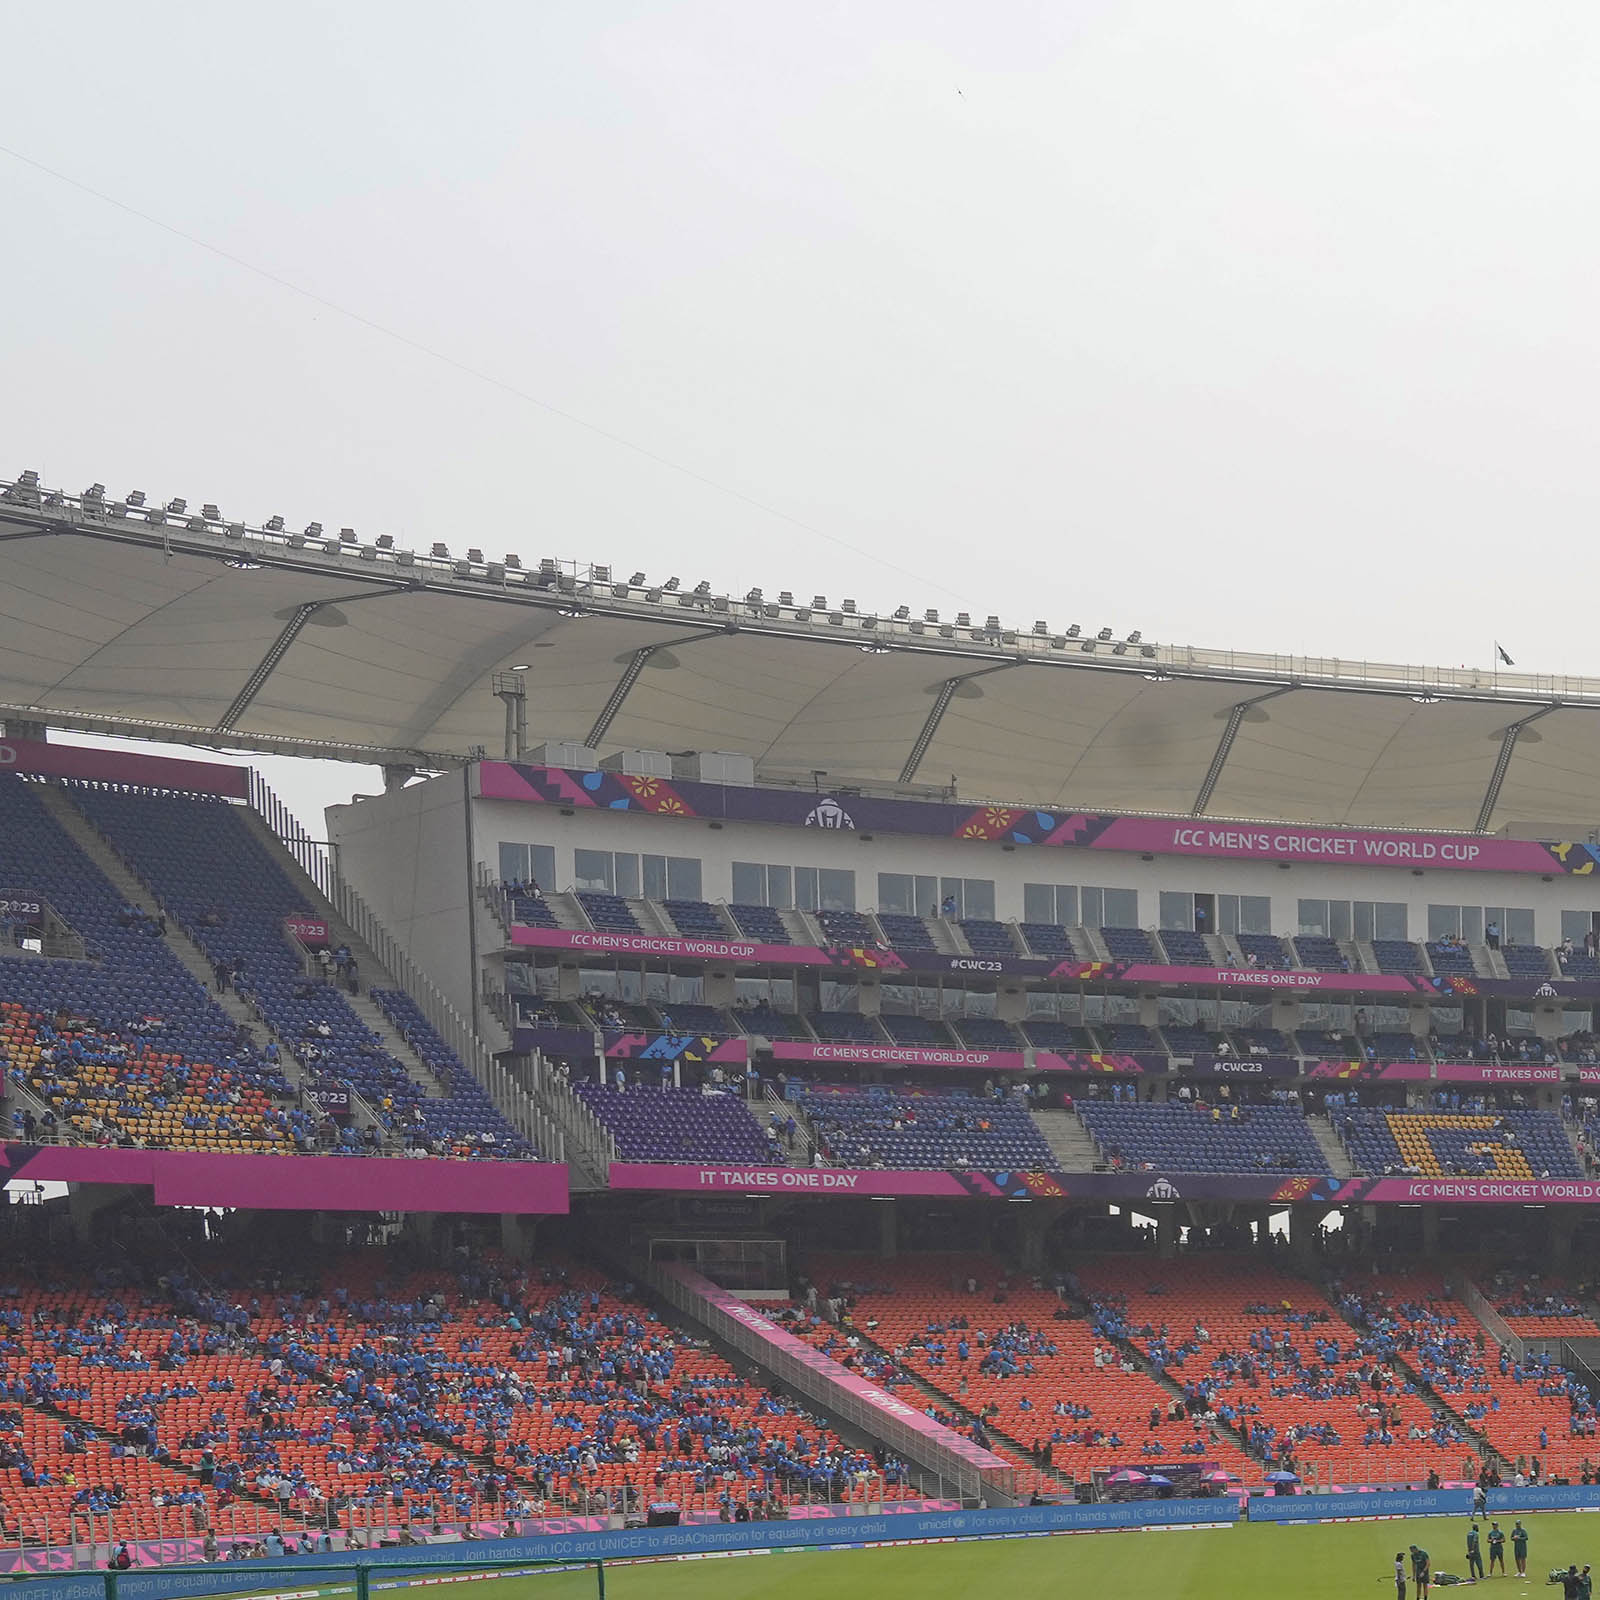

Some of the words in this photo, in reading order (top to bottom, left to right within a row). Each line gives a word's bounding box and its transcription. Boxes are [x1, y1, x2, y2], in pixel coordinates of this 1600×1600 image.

[1174, 828, 1202, 844] ICC
[1208, 831, 1270, 849] MEN'S
[1274, 835, 1357, 854] CRICKET
[1364, 840, 1435, 858] WORLD
[1441, 844, 1480, 861] CUP
[571, 935, 591, 945] ICC
[592, 936, 629, 948] MEN'S
[631, 938, 681, 951] CRICKET
[685, 942, 728, 954] WORLD
[730, 945, 754, 955] CUP
[951, 960, 1002, 971] #CWC23
[1218, 972, 1229, 981] IT
[1231, 973, 1269, 983] TAKES
[1271, 974, 1296, 984] ONE
[1298, 975, 1322, 985] DAY
[813, 1047, 830, 1057] ICC
[833, 1048, 869, 1059] MEN'S
[871, 1050, 919, 1060] CRICKET
[922, 1051, 964, 1062] WORLD
[966, 1054, 989, 1063] CUP
[1213, 1062, 1263, 1072] #CWC23
[1482, 1069, 1493, 1078] IT
[1495, 1070, 1531, 1079] TAKES
[1534, 1070, 1558, 1079] ONE
[700, 1171, 716, 1185] IT
[720, 1171, 779, 1186] TAKES
[782, 1172, 820, 1187] ONE
[823, 1173, 858, 1187] DAY
[1409, 1184, 1431, 1196] ICC
[1433, 1184, 1477, 1197] MEN'S
[1479, 1185, 1539, 1197] CRICKET
[1541, 1185, 1593, 1197] WORLD
